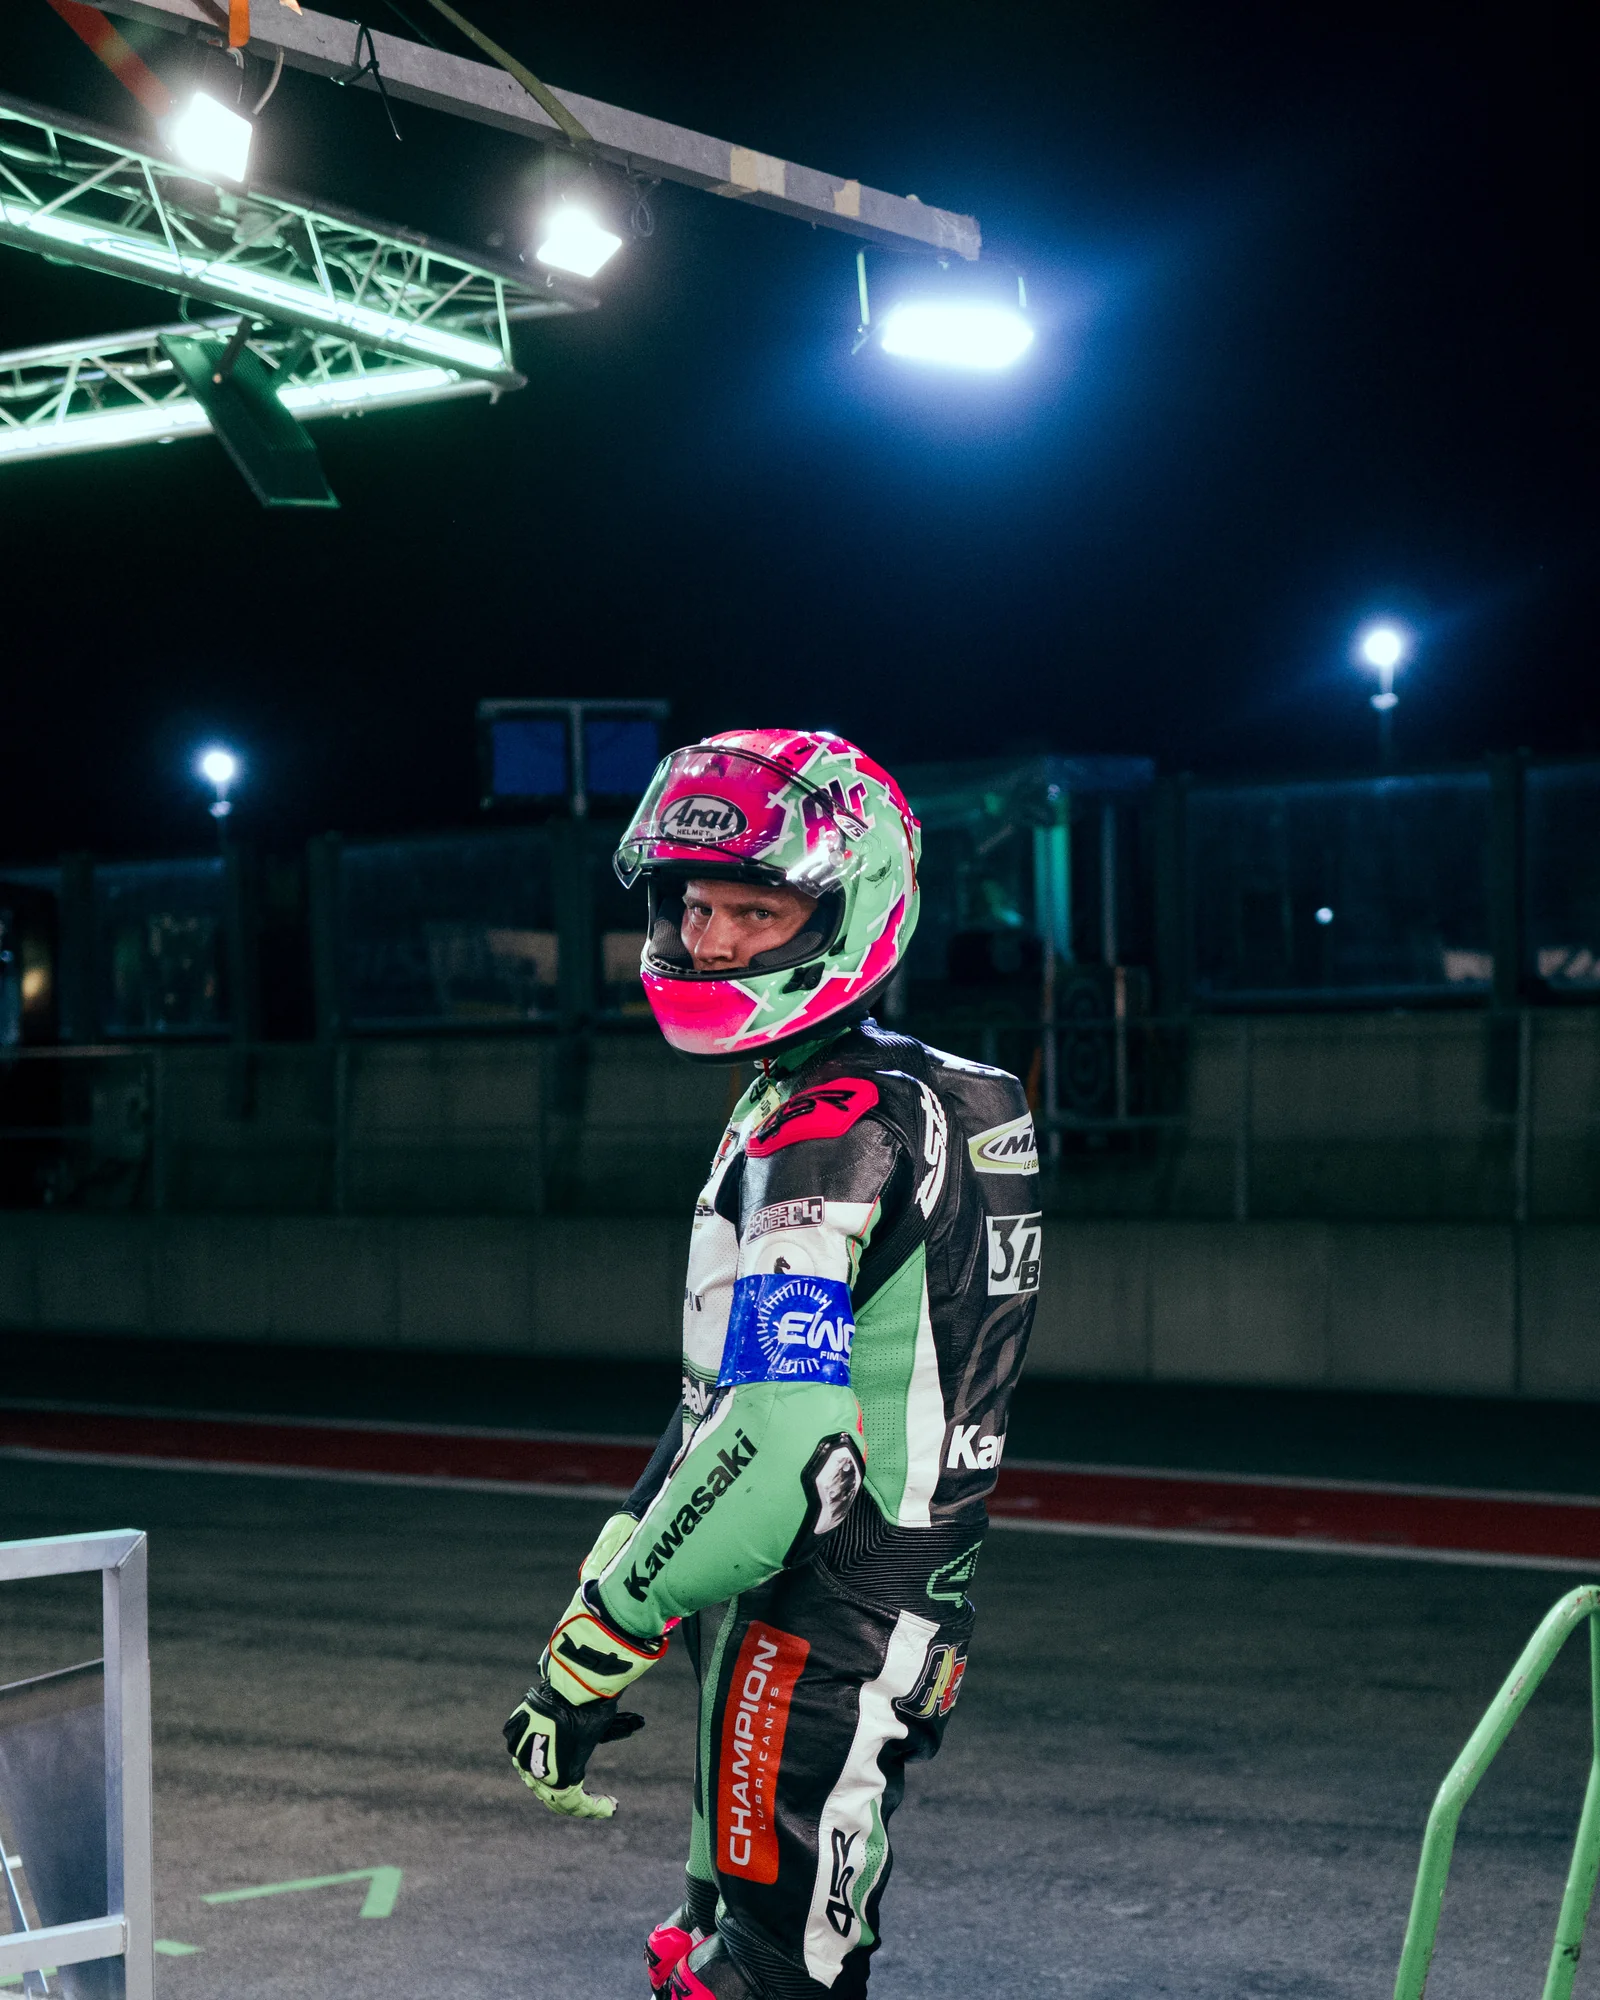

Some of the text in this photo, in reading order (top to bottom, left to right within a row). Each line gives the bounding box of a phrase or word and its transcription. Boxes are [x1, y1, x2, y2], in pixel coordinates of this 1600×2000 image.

[666, 799, 736, 831] Arai
[749, 1206, 787, 1228] HORSE
[749, 1215, 789, 1238] POWER
[820, 1351, 839, 1361] FIM
[623, 1428, 758, 1603] Kawasaki
[730, 1639, 778, 1866] CHAMPION
[755, 1686, 780, 1832] LUBRICANTS
